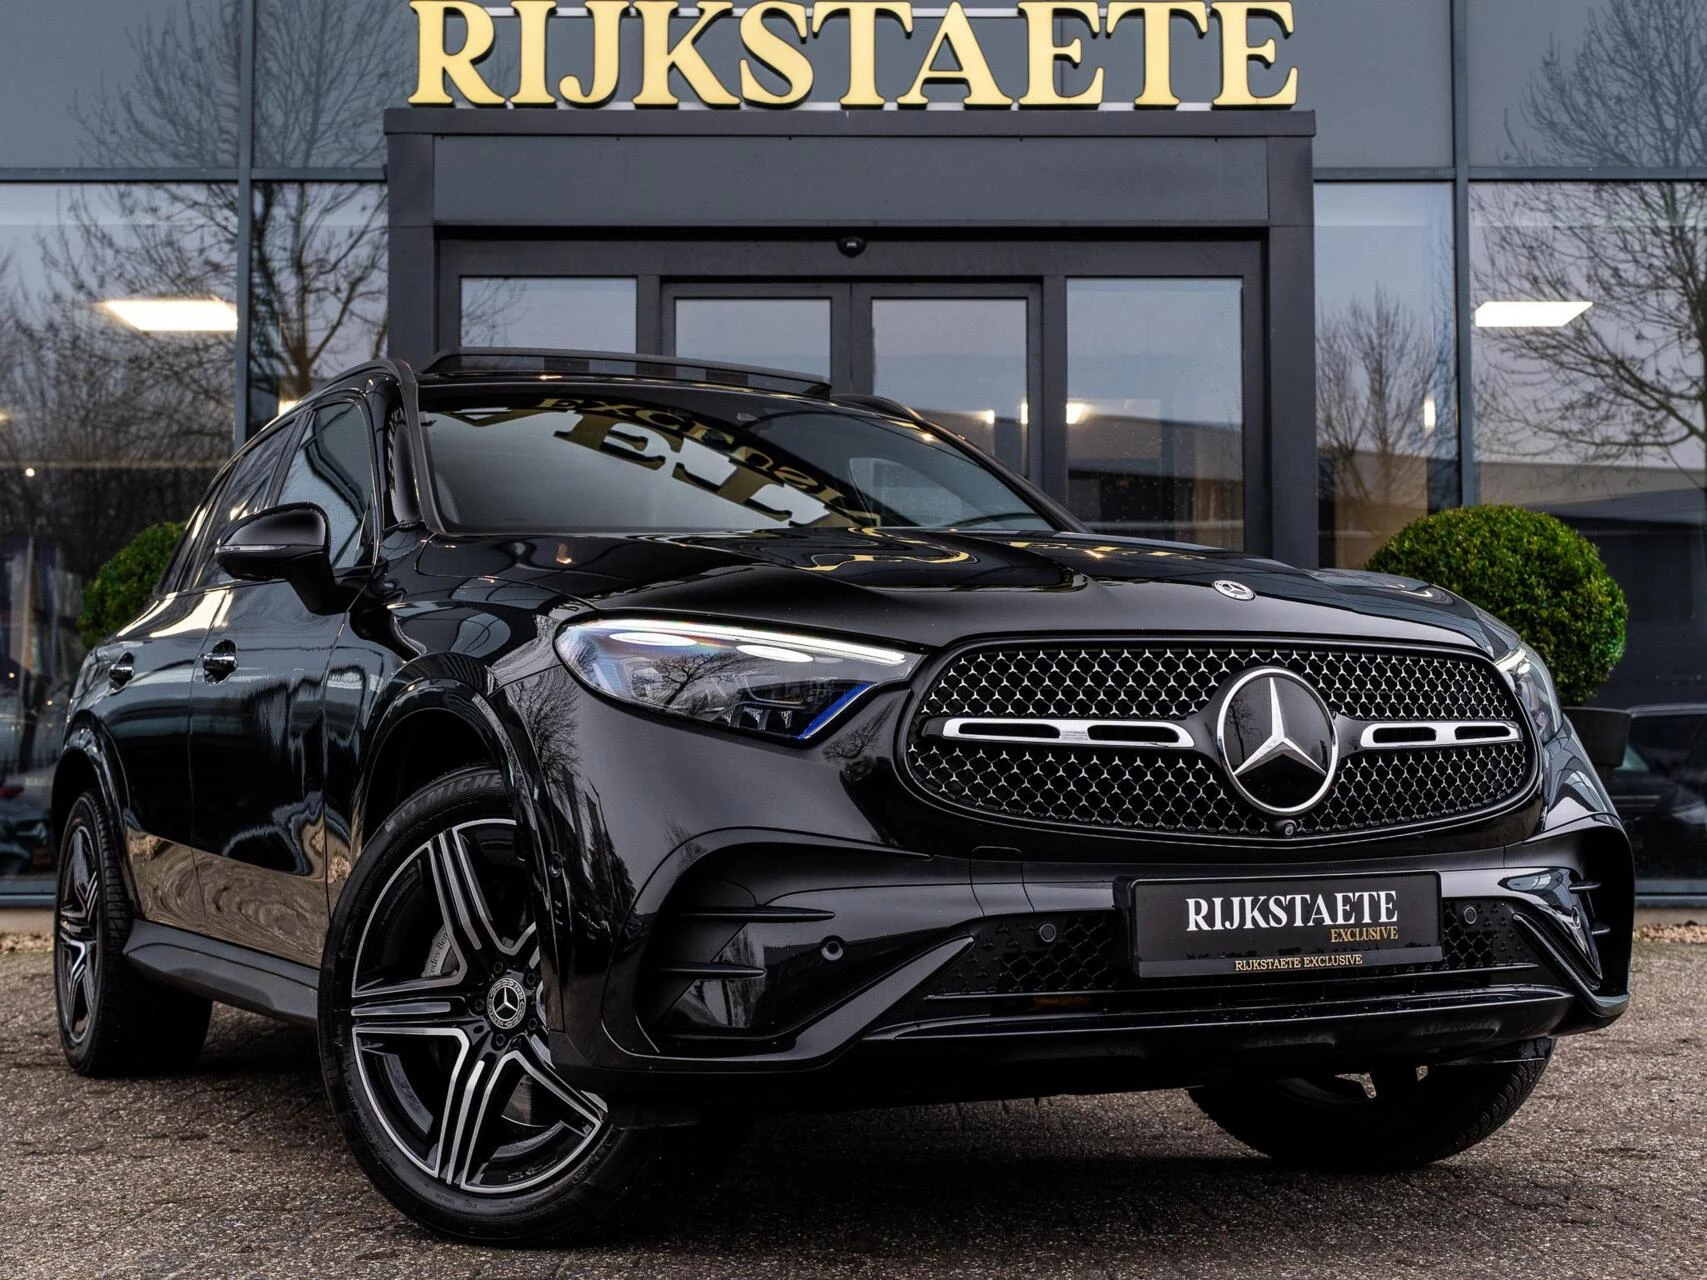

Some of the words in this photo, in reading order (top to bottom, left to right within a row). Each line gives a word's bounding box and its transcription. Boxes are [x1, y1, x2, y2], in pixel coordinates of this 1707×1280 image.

[408, 1, 1299, 107] RIJKSTAETE
[426, 774, 502, 806] MICHE
[1186, 890, 1399, 932] RIJKSTAETE
[1330, 925, 1399, 943] EXCLUSIVE
[1234, 956, 1301, 972] RIJKSTAETE
[1303, 954, 1363, 969] EXCLUSIVE
